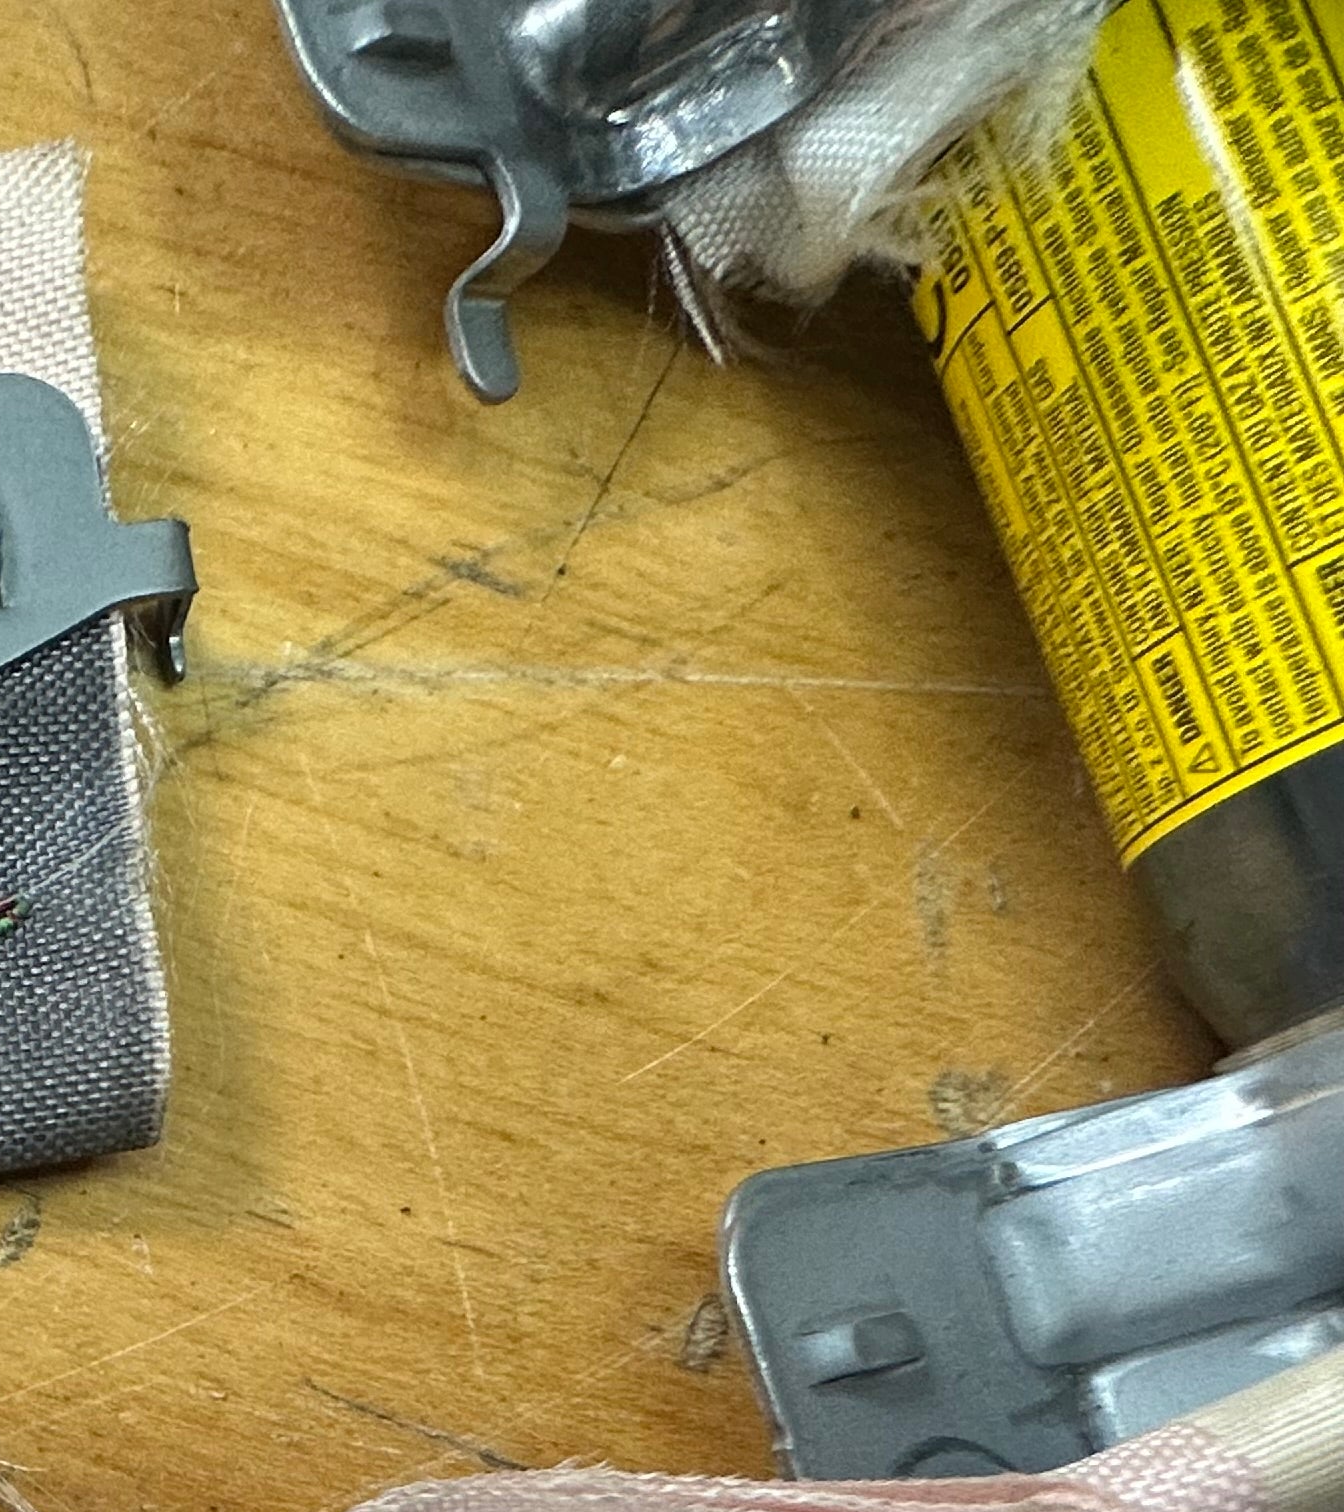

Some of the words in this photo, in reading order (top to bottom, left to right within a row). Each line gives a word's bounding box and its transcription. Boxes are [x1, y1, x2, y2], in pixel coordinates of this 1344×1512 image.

[1084, 160, 1116, 192] for
[1095, 187, 1146, 265] Manual
[1154, 194, 1216, 295] PRESSION
[1080, 247, 1129, 320] vehicle
[1126, 263, 1177, 330] Repair
[1111, 319, 1159, 396] another
[1195, 295, 1241, 359] HAUTE
[1141, 396, 1177, 443] onto
[1227, 376, 1264, 418] GAZ
[1244, 418, 1278, 451] DU
[1259, 453, 1317, 550] CONTIENT
[1300, 461, 1340, 506] DES
[1186, 513, 1249, 614] electricity
[1224, 512, 1269, 575] above
[1227, 614, 1263, 661] with
[1258, 595, 1332, 722] temperature
[1148, 652, 1202, 743] DANGER
[1214, 673, 1252, 727] avoid
[1246, 663, 1294, 739] contact
